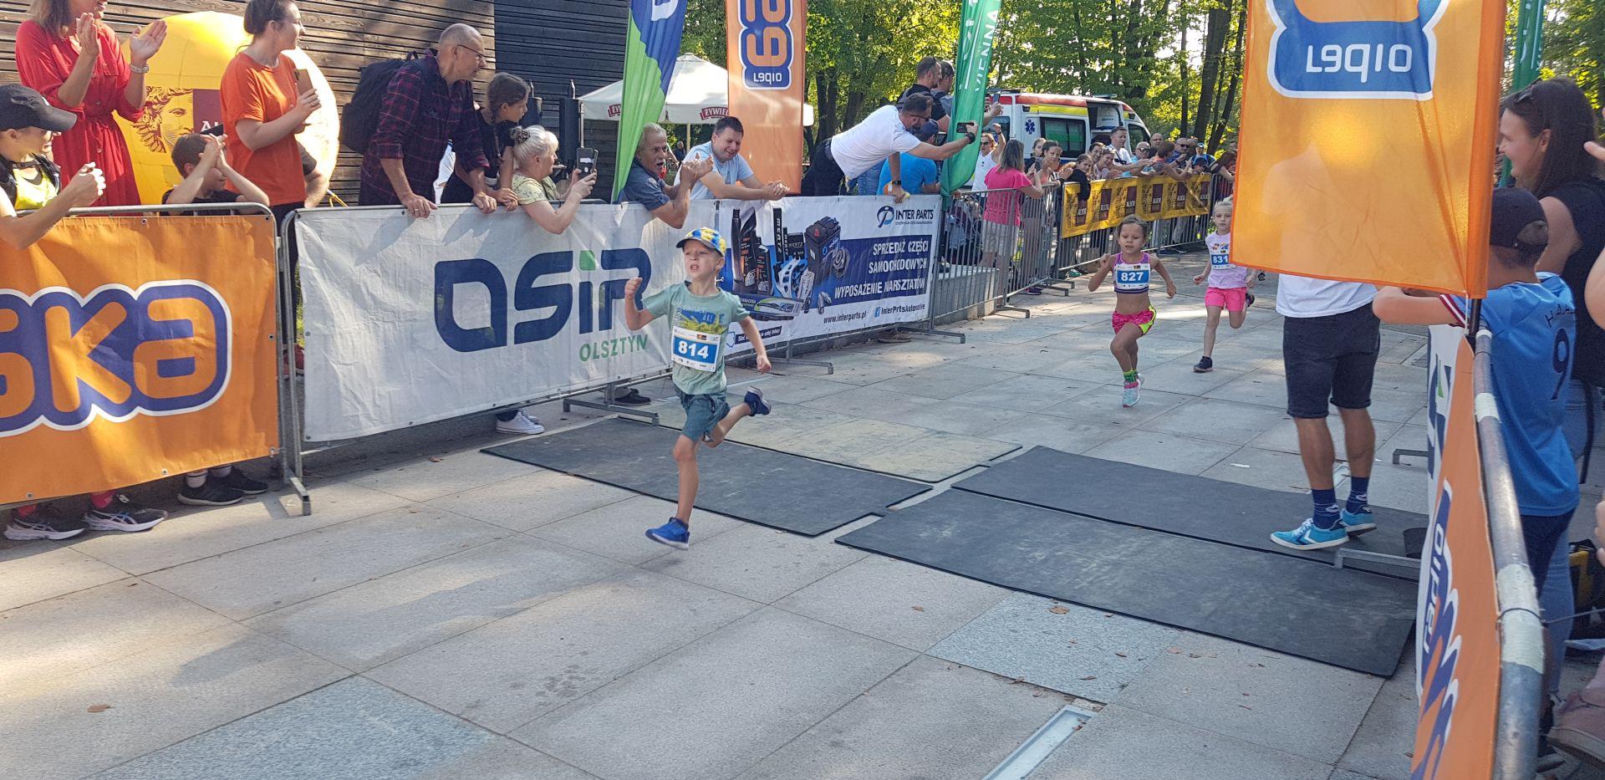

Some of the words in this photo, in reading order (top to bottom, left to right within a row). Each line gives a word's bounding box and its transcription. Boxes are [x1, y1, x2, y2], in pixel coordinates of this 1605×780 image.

[895, 209, 915, 220] INTER
[916, 209, 934, 220] PARTS
[872, 238, 906, 256] SPRZEDAŻ
[907, 238, 929, 255] CZĘŚCI
[1121, 272, 1144, 281] 827
[834, 280, 883, 299] WYPOSAŻENIE
[578, 333, 649, 362] OLSZTYN
[678, 341, 709, 359] 814
[1550, 328, 1570, 401] 9
[1423, 522, 1445, 655] radio
